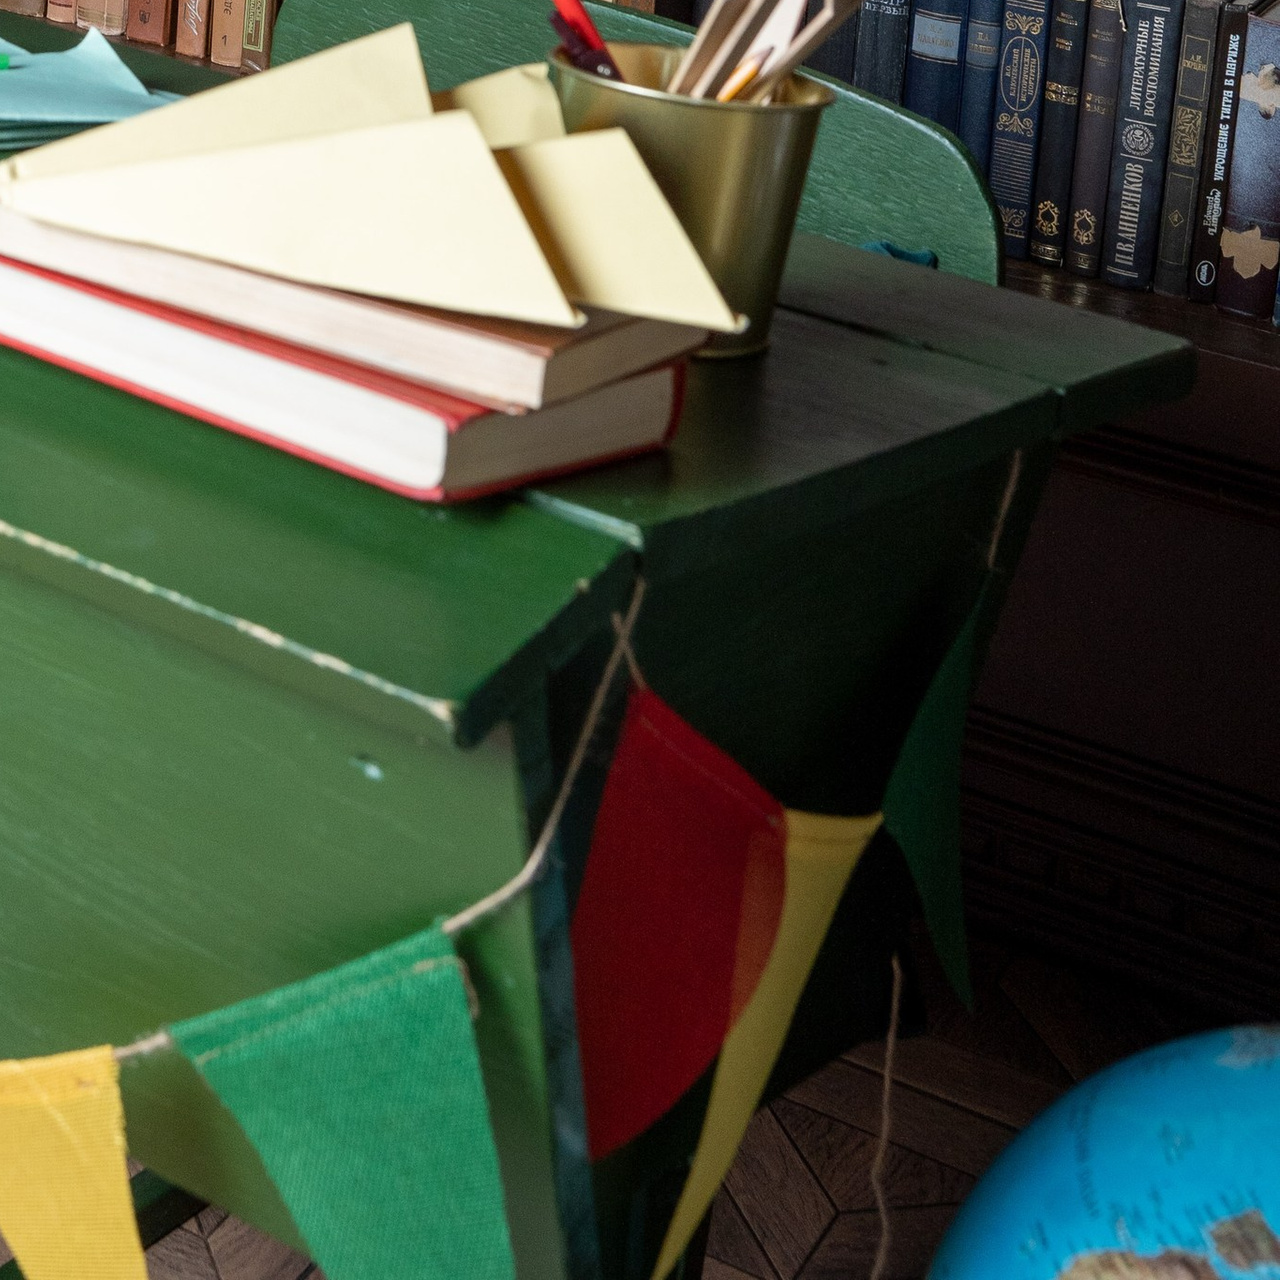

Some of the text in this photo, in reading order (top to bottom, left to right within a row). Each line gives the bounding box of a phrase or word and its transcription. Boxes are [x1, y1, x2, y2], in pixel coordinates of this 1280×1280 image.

[1009, 48, 1020, 97] КЛЮЧЕВСКИЙ
[1022, 47, 1032, 103] ИСТОРИЧЕСКИЕ
[1027, 58, 1037, 96] ПОРТРЕТЫ
[1128, 19, 1151, 111] ЛИТЕРАТУРНЫЕ
[1143, 15, 1166, 118] ВОСПОМИНАНИЯ
[1183, 60, 1208, 73] ГЕРЦЕН
[1213, 33, 1241, 183] УКРОЩЕНИЕ ТИГРА В ПАРИЖЕ
[1114, 161, 1144, 268] П.В.АННЕНКОВ
[1203, 195, 1215, 228] Edward
